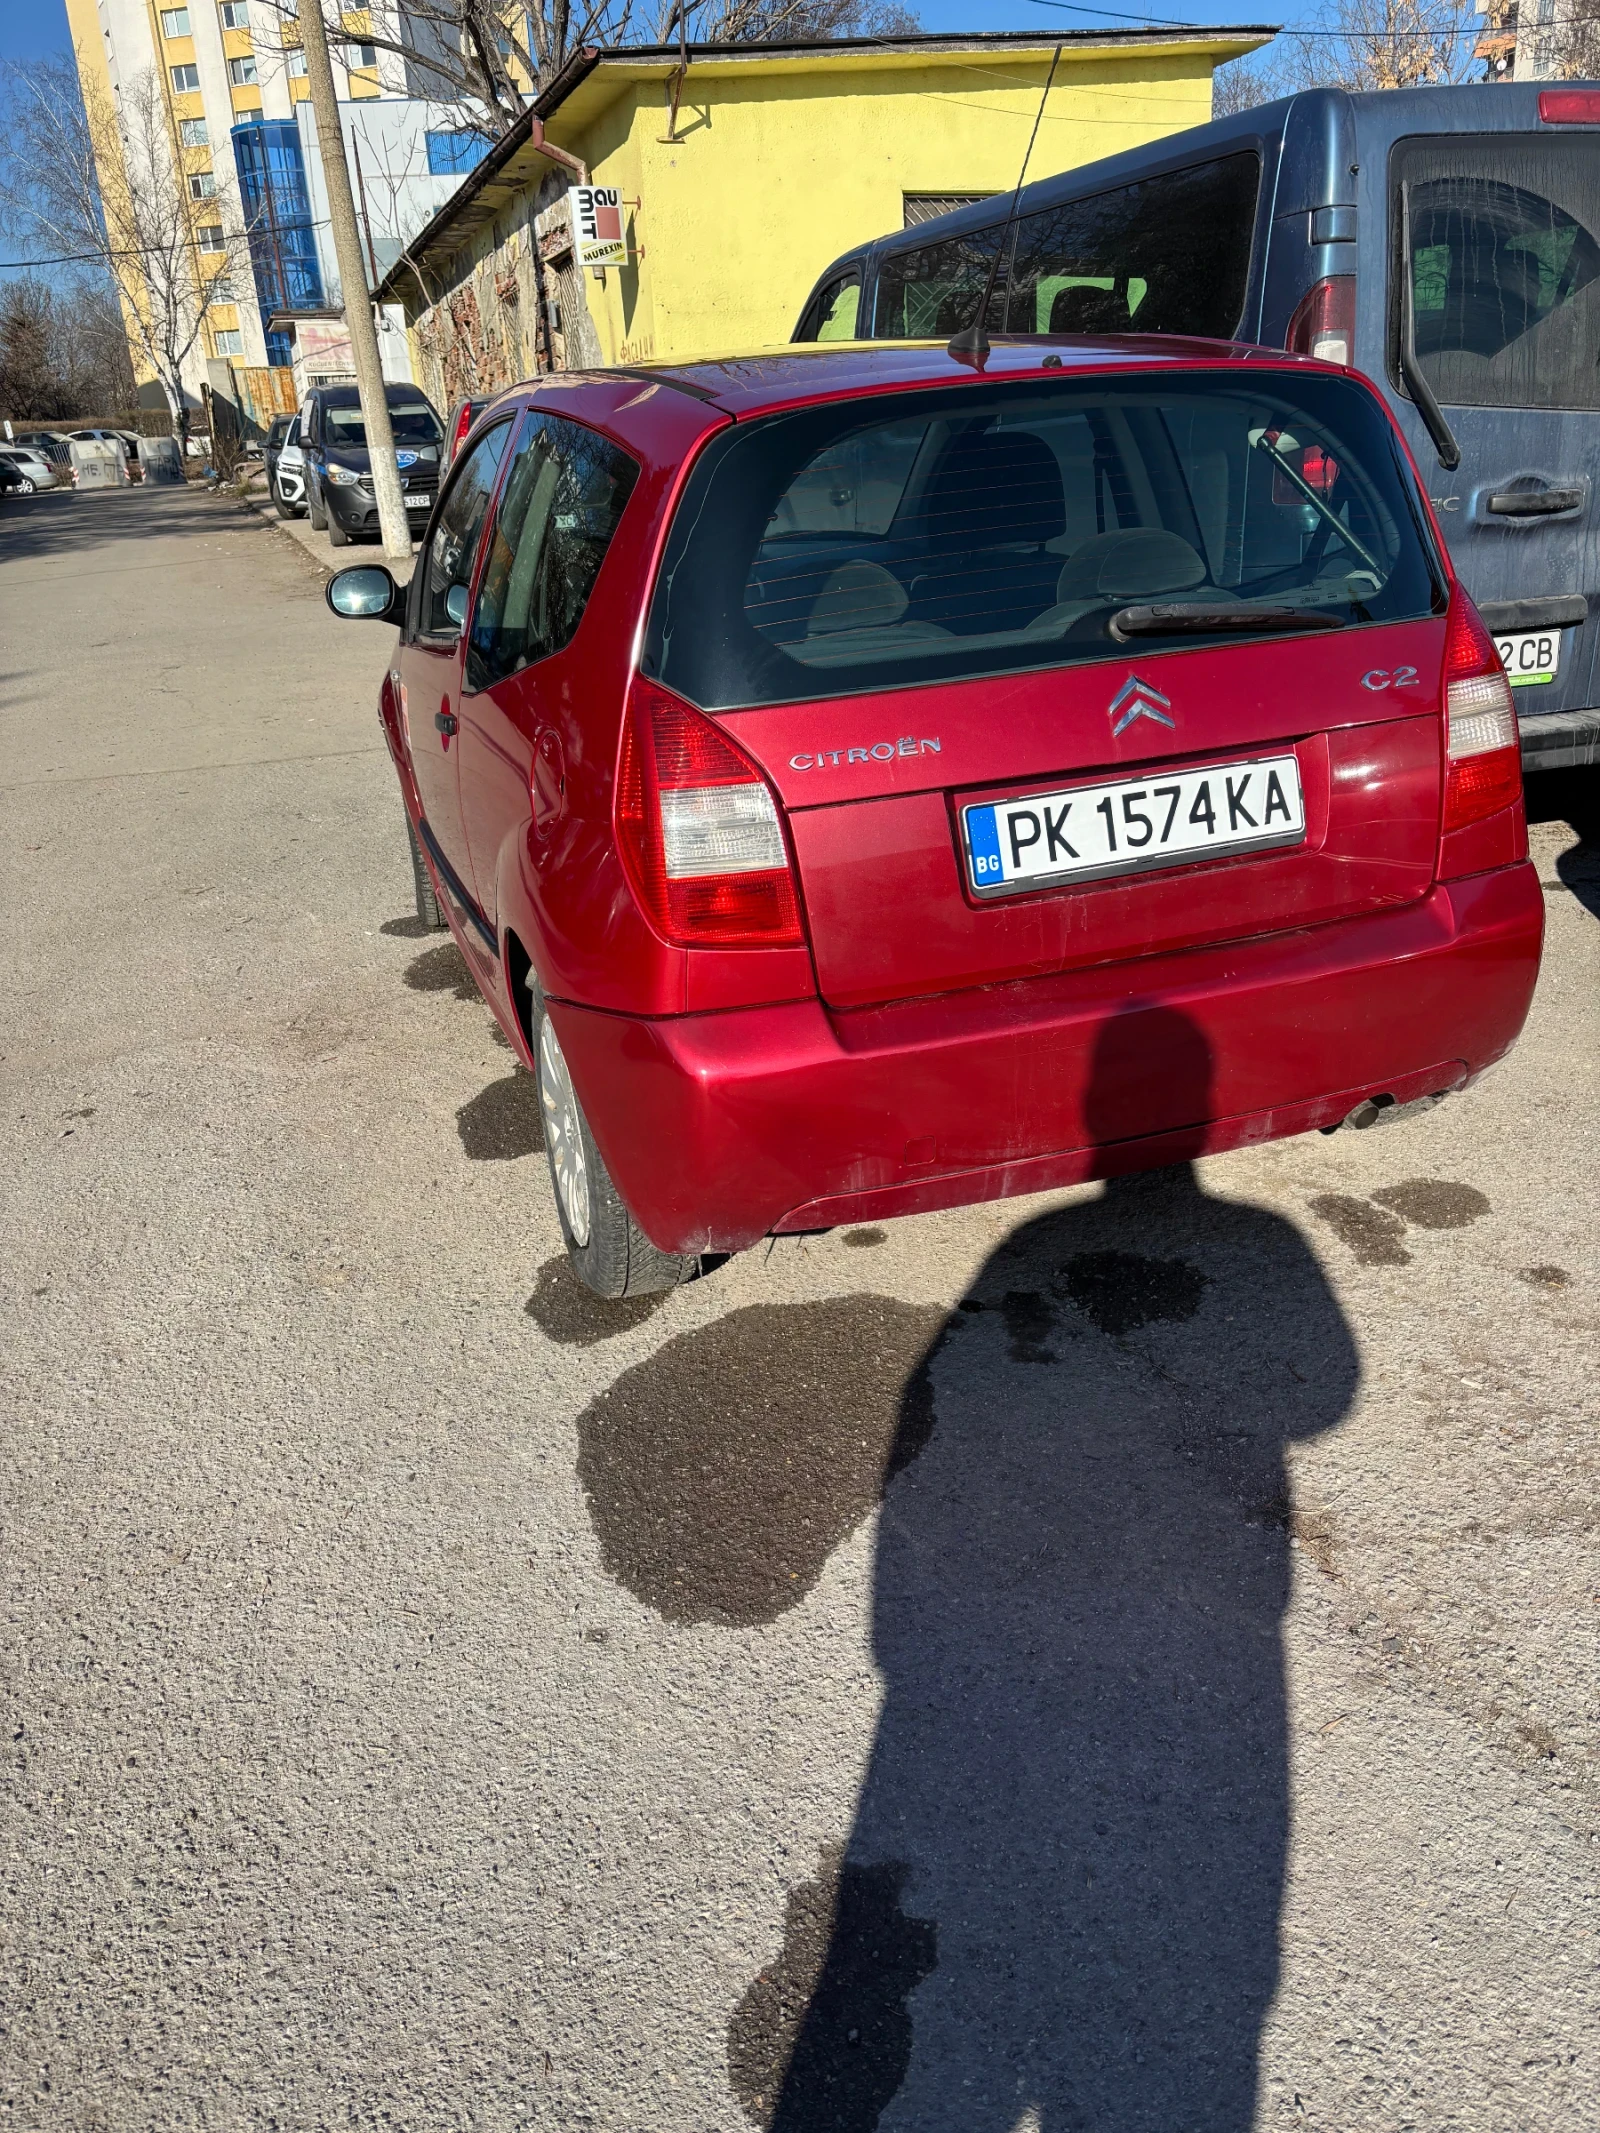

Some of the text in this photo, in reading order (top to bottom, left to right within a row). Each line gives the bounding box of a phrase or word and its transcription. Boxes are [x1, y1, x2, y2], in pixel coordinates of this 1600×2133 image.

[583, 242, 623, 262] MUREXIN
[1360, 666, 1420, 691] C2
[788, 735, 941, 771] CITROËN
[976, 854, 999, 874] BG
